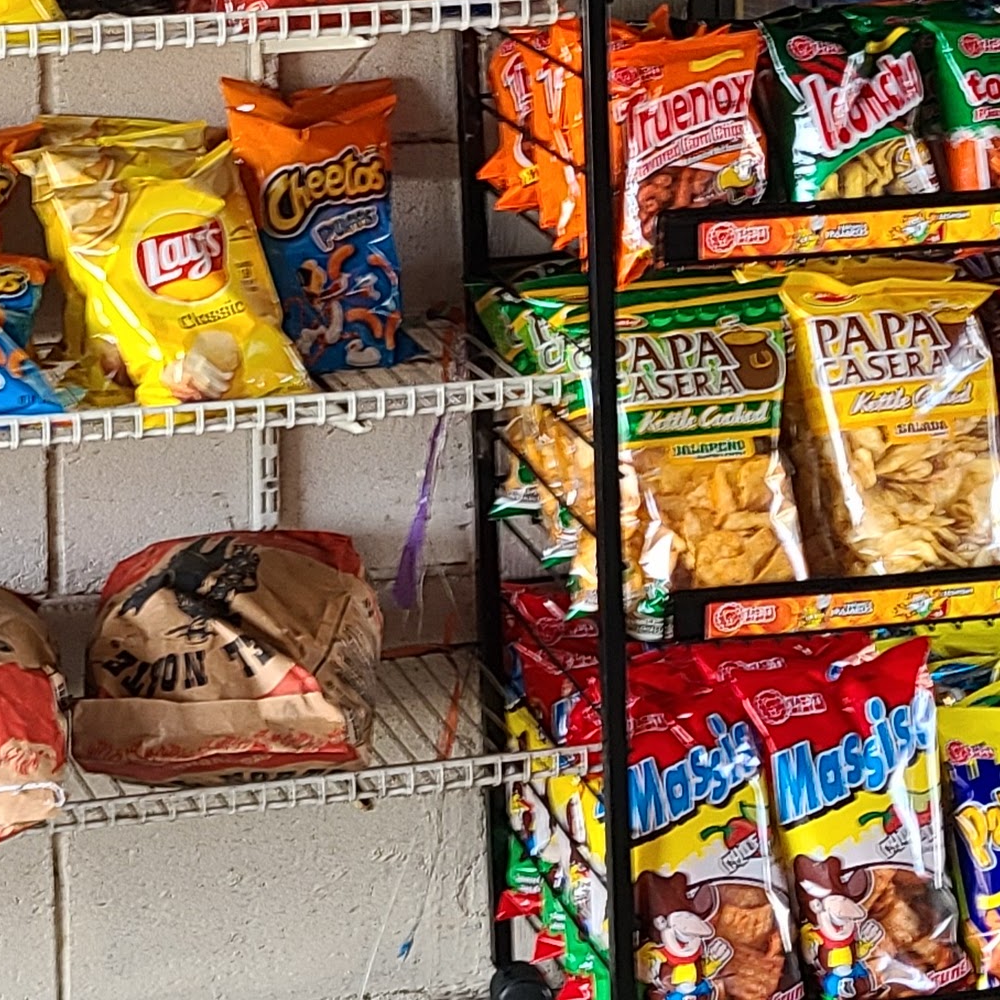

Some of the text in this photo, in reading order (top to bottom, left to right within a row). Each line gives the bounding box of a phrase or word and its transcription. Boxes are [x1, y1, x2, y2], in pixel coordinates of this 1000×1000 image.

[261, 145, 388, 239] Cheetos
[138, 219, 225, 288] Lay's
[177, 298, 248, 330] Classic
[814, 311, 942, 359] PAPA
[632, 369, 739, 402] ASERA
